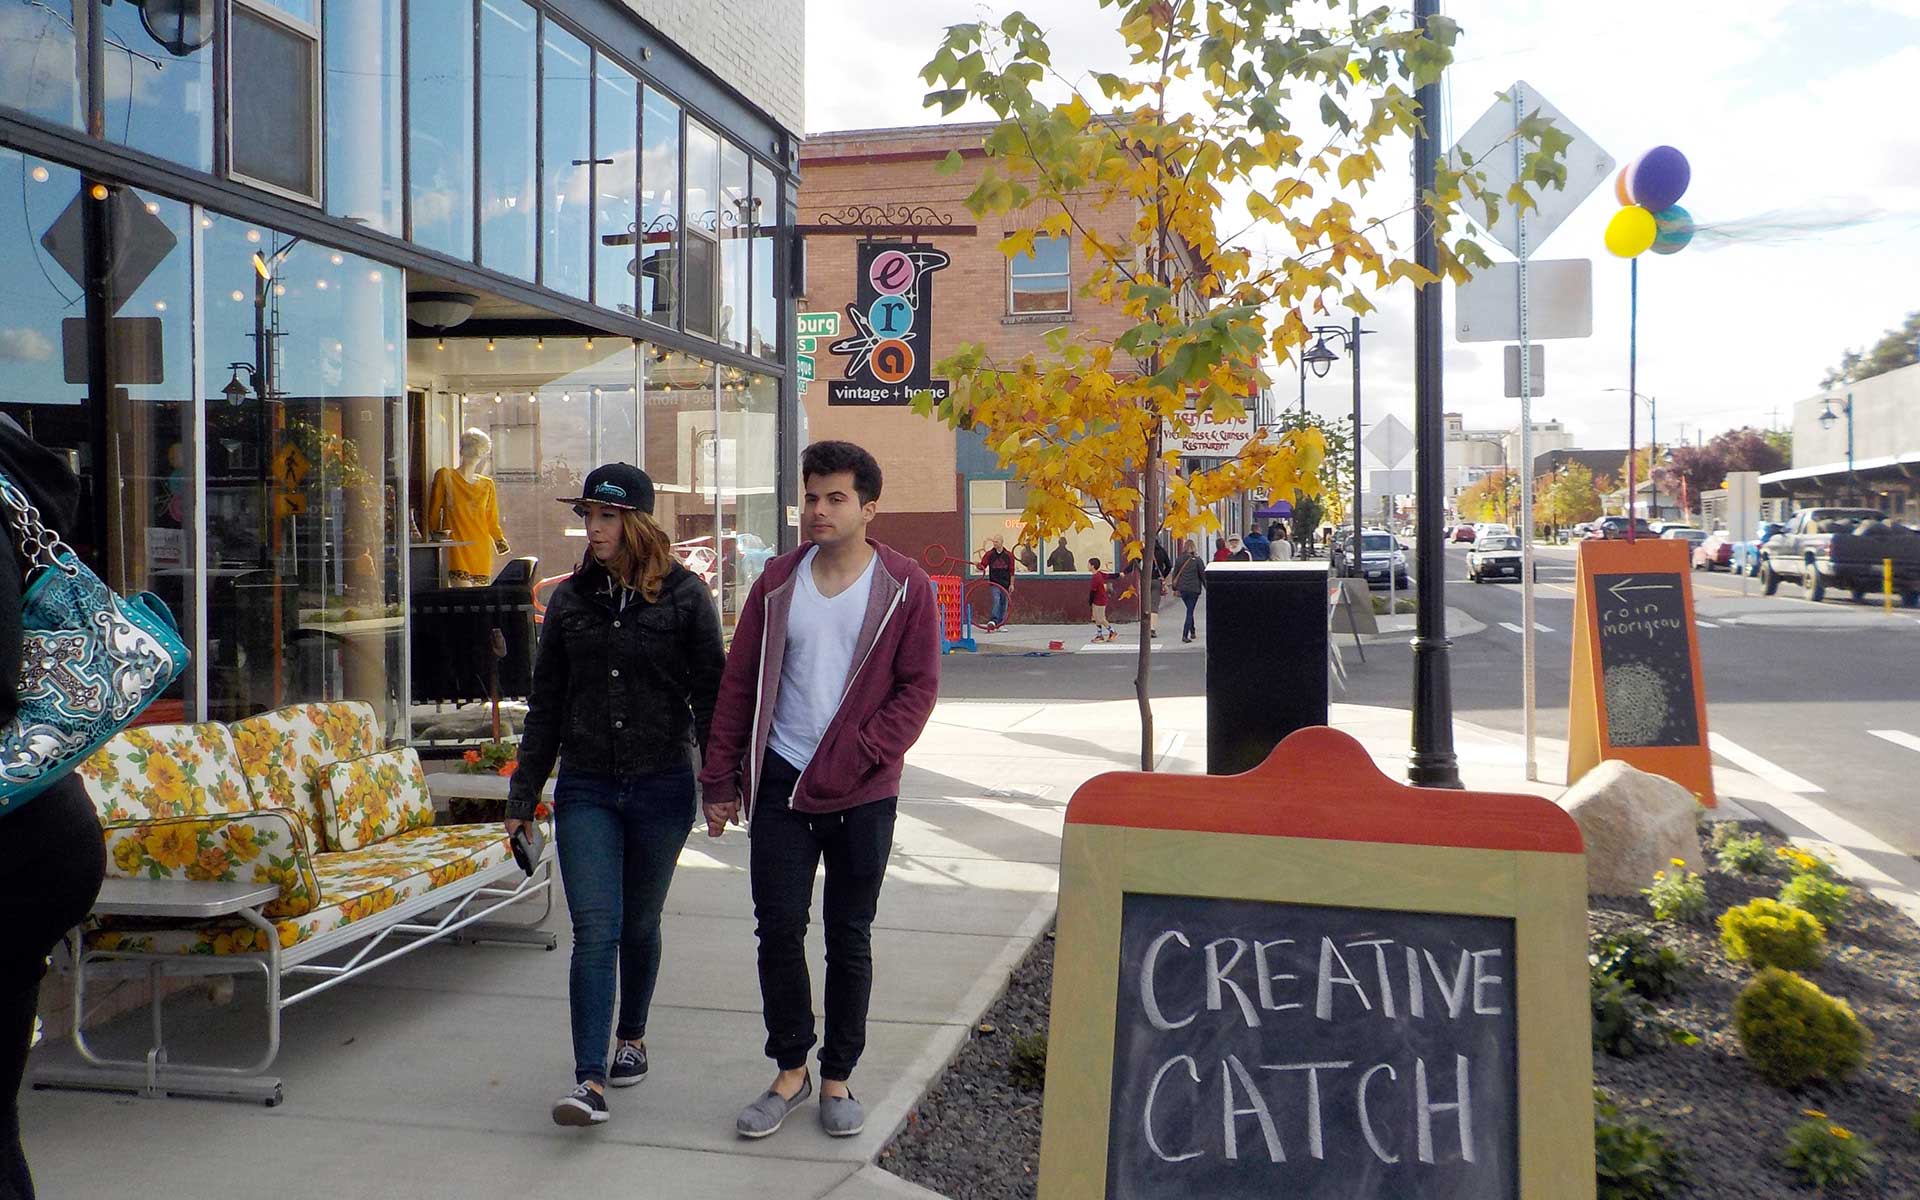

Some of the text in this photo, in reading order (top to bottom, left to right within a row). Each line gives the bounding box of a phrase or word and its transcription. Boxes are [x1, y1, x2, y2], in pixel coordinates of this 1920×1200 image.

[873, 257, 909, 374] era
[835, 386, 889, 401] vintage
[1140, 930, 1503, 1030] CREATIVE
[1144, 1054, 1475, 1164] CATCH
